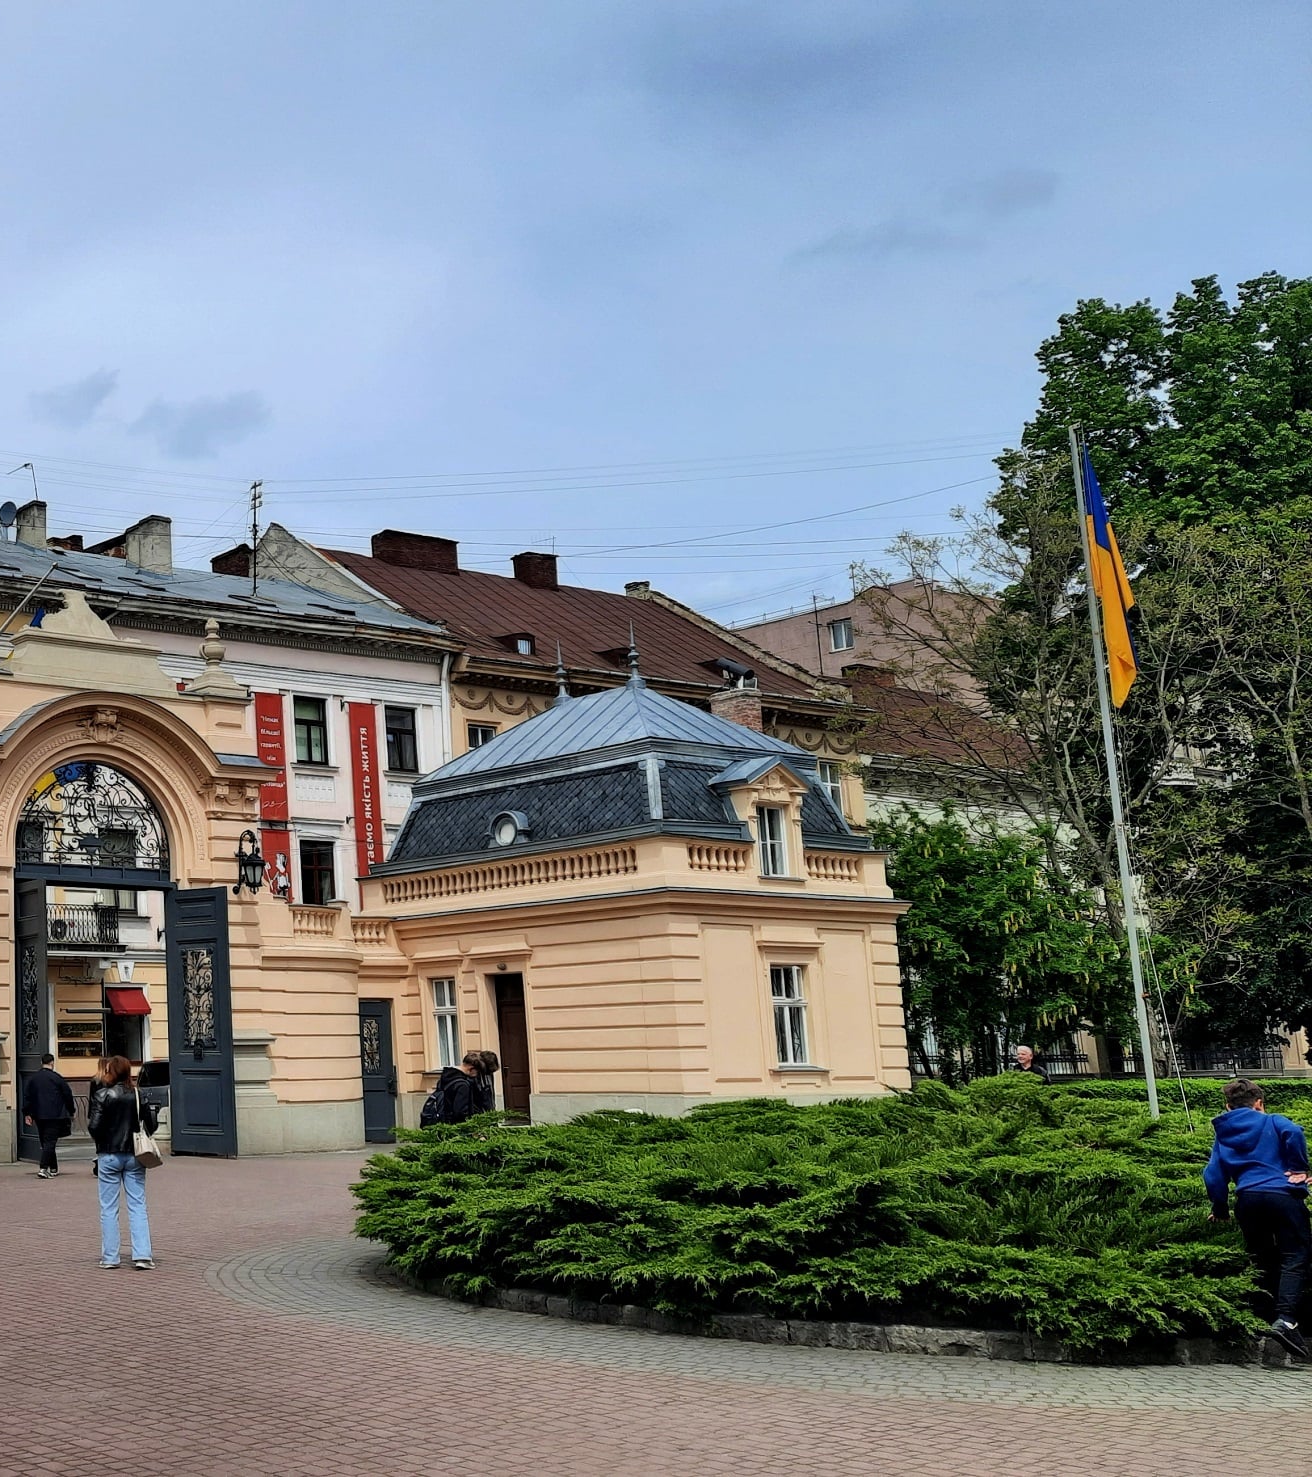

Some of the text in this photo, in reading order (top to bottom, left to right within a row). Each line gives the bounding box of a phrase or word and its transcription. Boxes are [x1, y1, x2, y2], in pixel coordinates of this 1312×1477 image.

[359, 726, 375, 875] таємо якість життя
